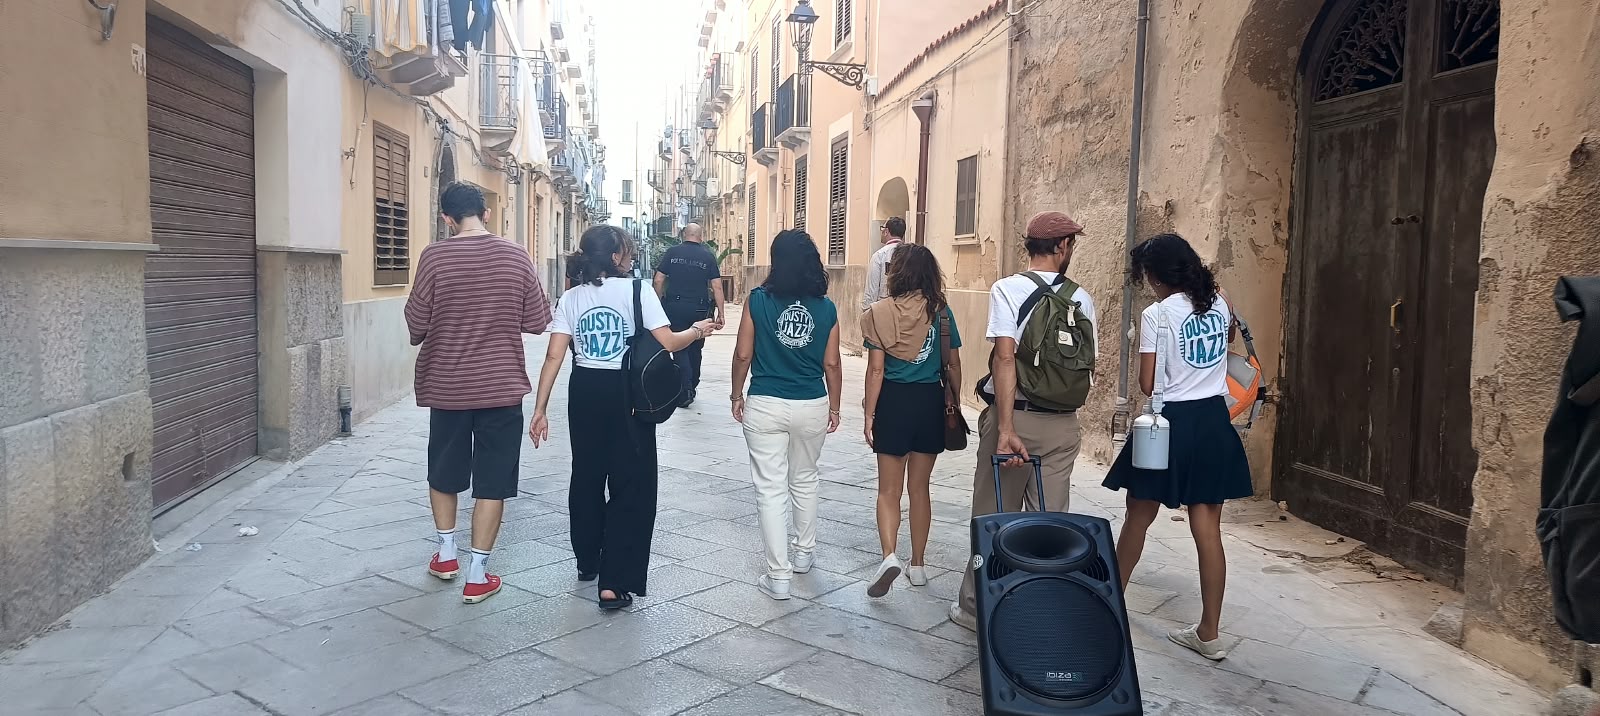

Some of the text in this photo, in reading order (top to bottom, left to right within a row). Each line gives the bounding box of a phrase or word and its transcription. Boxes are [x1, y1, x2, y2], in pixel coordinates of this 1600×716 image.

[580, 311, 620, 333] DUSTY
[784, 310, 809, 324] DUSTY
[1185, 313, 1223, 339] DUSTY
[782, 321, 808, 338] JAZZ
[583, 331, 621, 357] JAZZ
[1187, 332, 1226, 364] JAZZ
